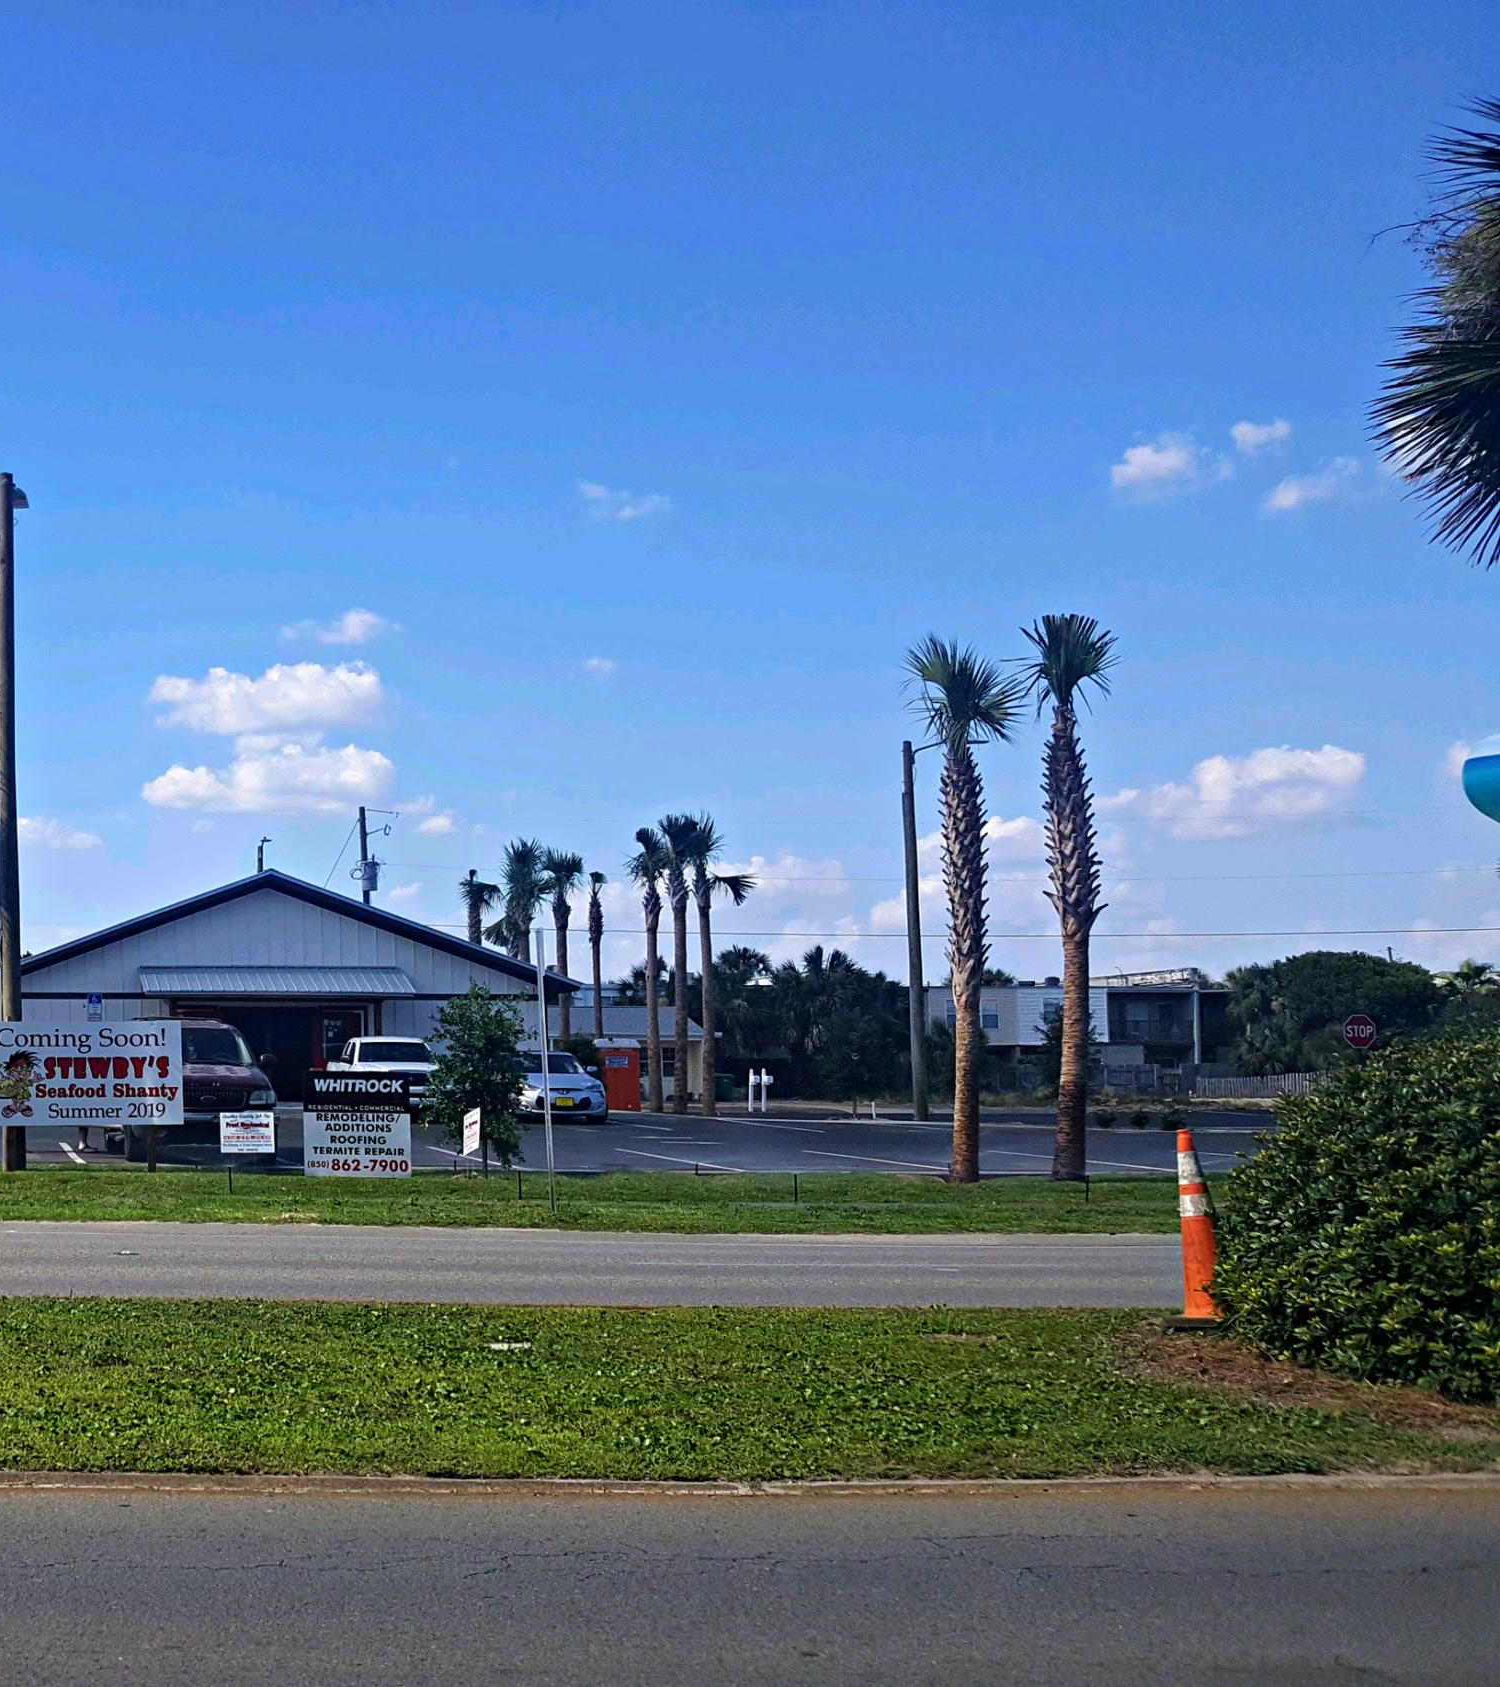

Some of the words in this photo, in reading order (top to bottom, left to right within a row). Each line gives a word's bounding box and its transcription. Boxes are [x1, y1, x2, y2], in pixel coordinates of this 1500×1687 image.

[99, 1028, 166, 1047] Soon!
[1346, 1025, 1374, 1037] STOP
[43, 1056, 170, 1079] STEWBY'S
[35, 1083, 106, 1099] Seafood
[113, 1084, 179, 1101] Shanty
[314, 1079, 404, 1093] WHITROCK
[48, 1103, 123, 1119] Summer
[128, 1102, 166, 1118] 2019
[316, 1113, 401, 1123] REMODELING/
[325, 1123, 392, 1133] ADDITIONS
[330, 1135, 387, 1145] ROOFING
[312, 1146, 360, 1155] TERMITE
[364, 1148, 405, 1156] REPAIR
[307, 1160, 330, 1169] (850)
[331, 1158, 409, 1173] 862-7900
